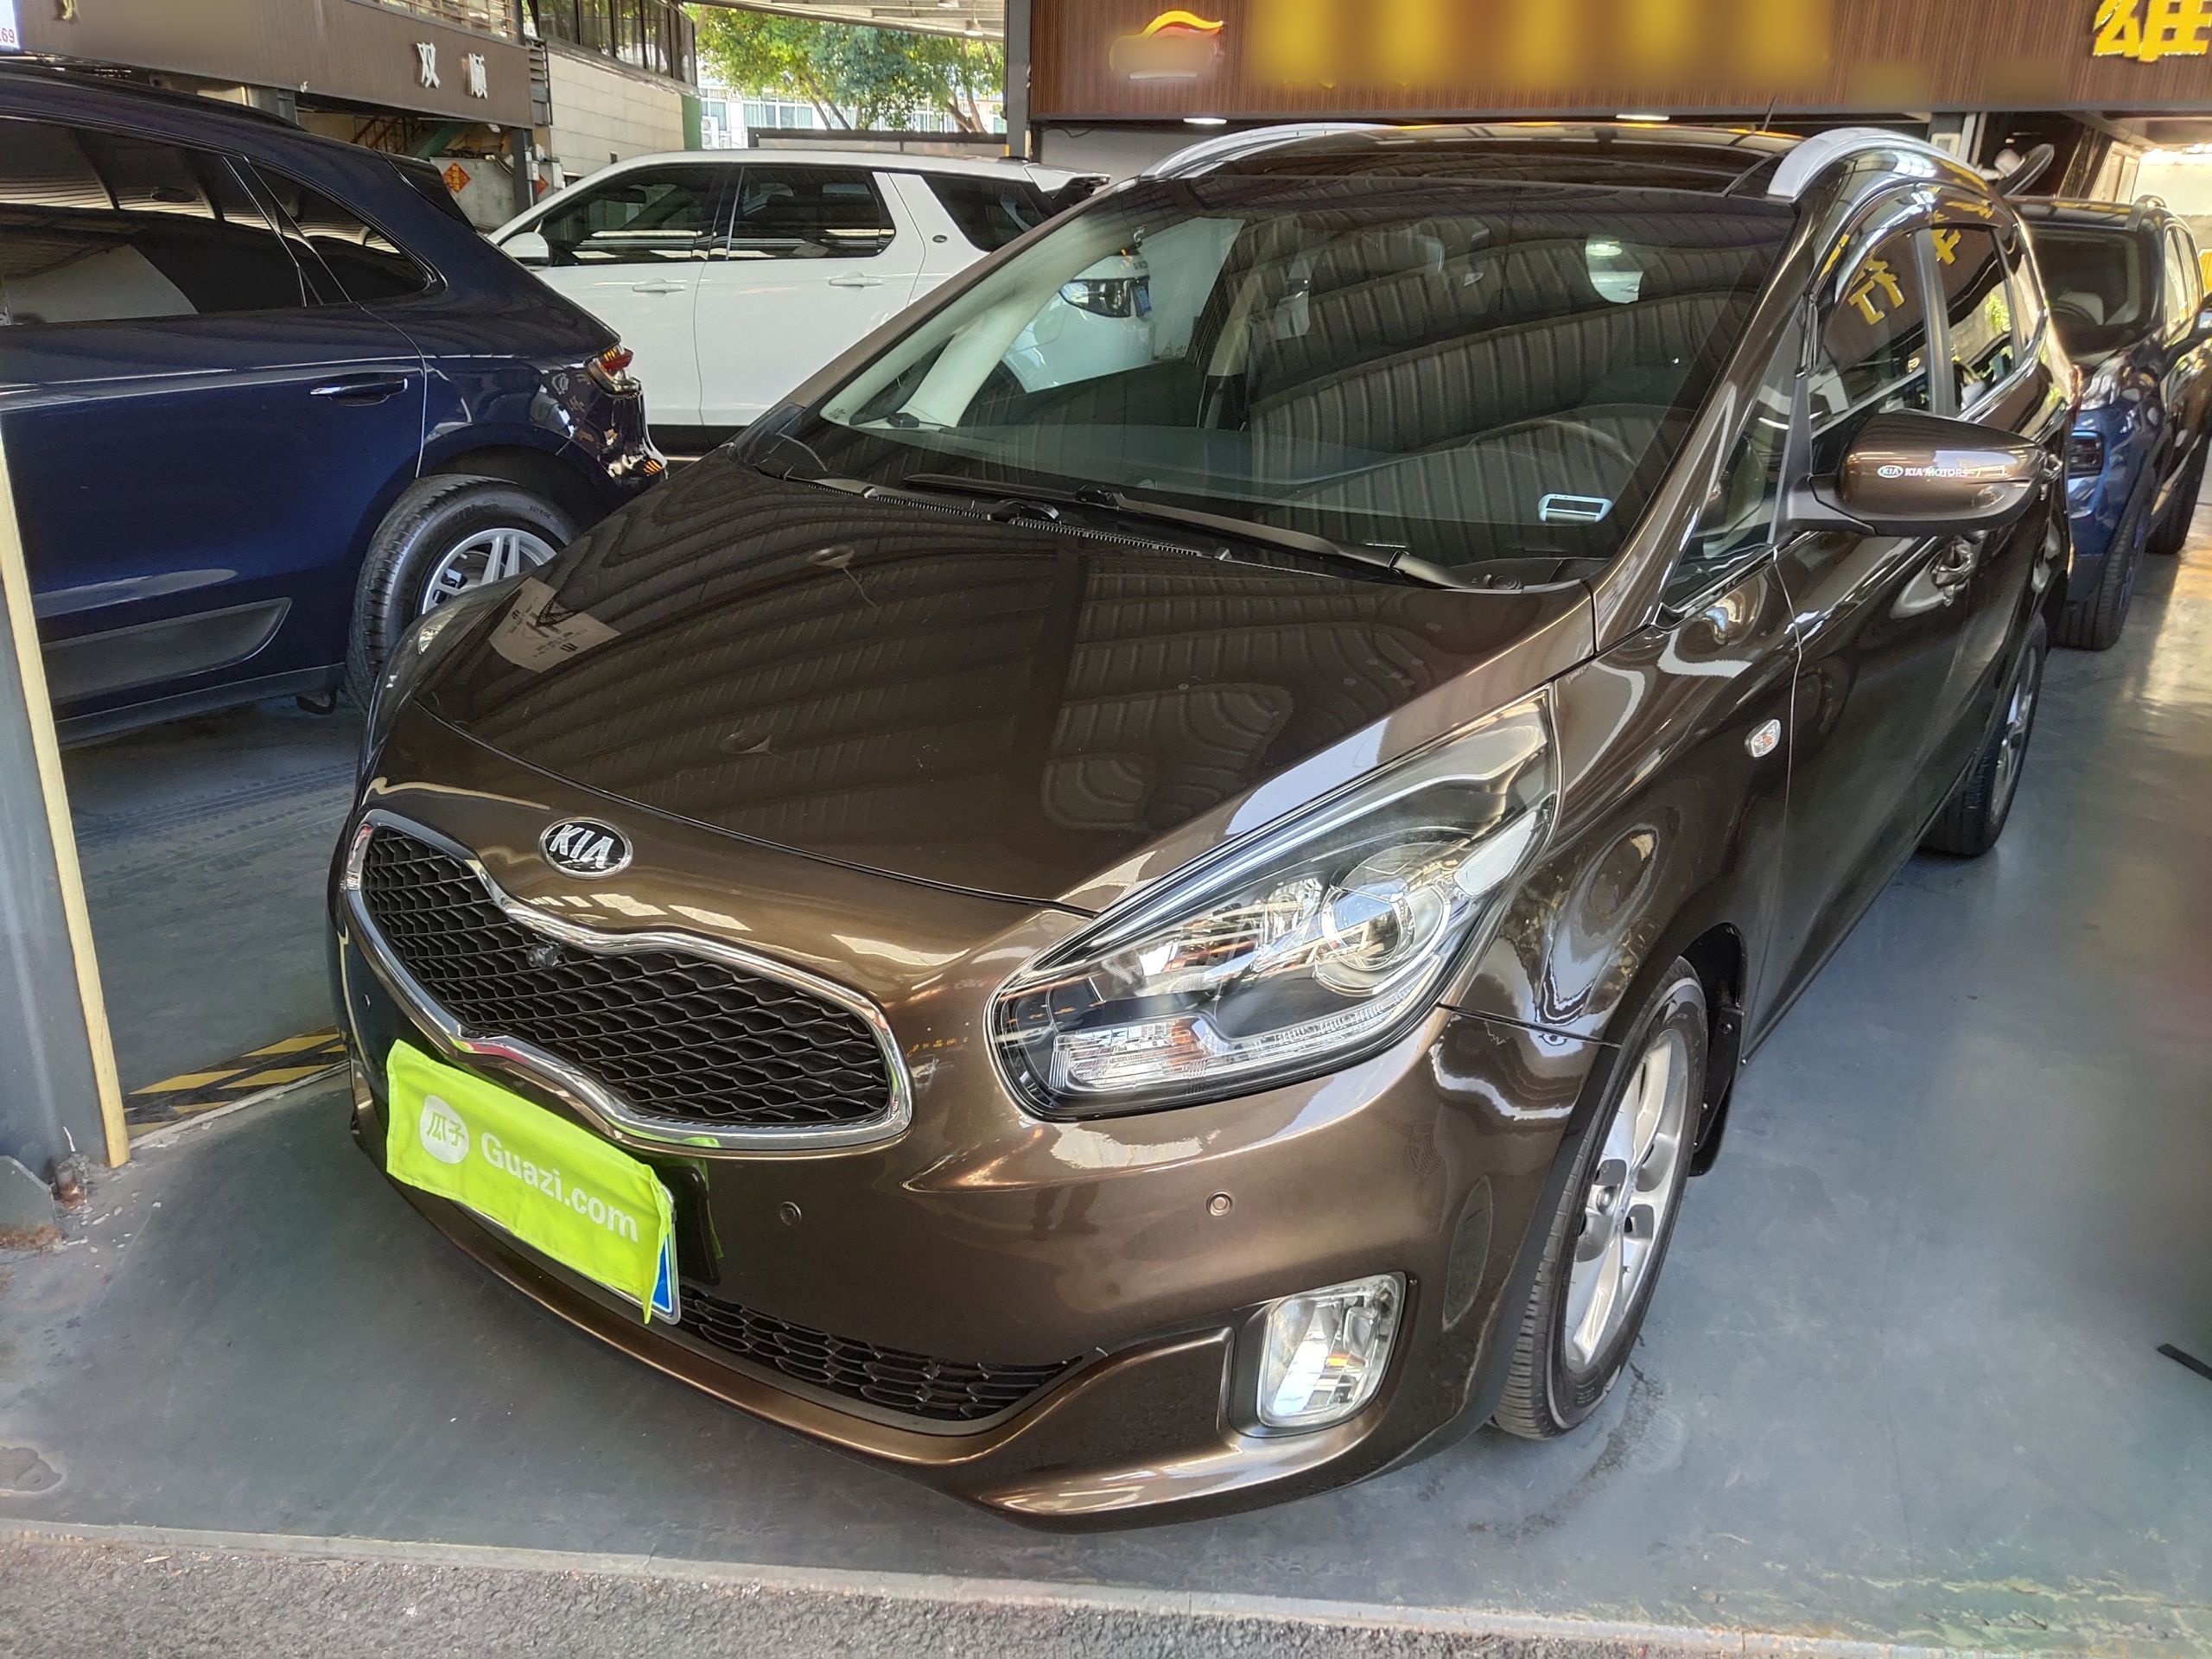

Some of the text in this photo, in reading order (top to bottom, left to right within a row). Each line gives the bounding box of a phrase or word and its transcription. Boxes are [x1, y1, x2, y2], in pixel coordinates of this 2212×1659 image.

[0, 28, 15, 43] 69
[1904, 467, 1967, 477] KIA MOTORS
[550, 824, 614, 869] KIA
[426, 1112, 465, 1147] 瓜子
[481, 1132, 638, 1243] Guazi.com
